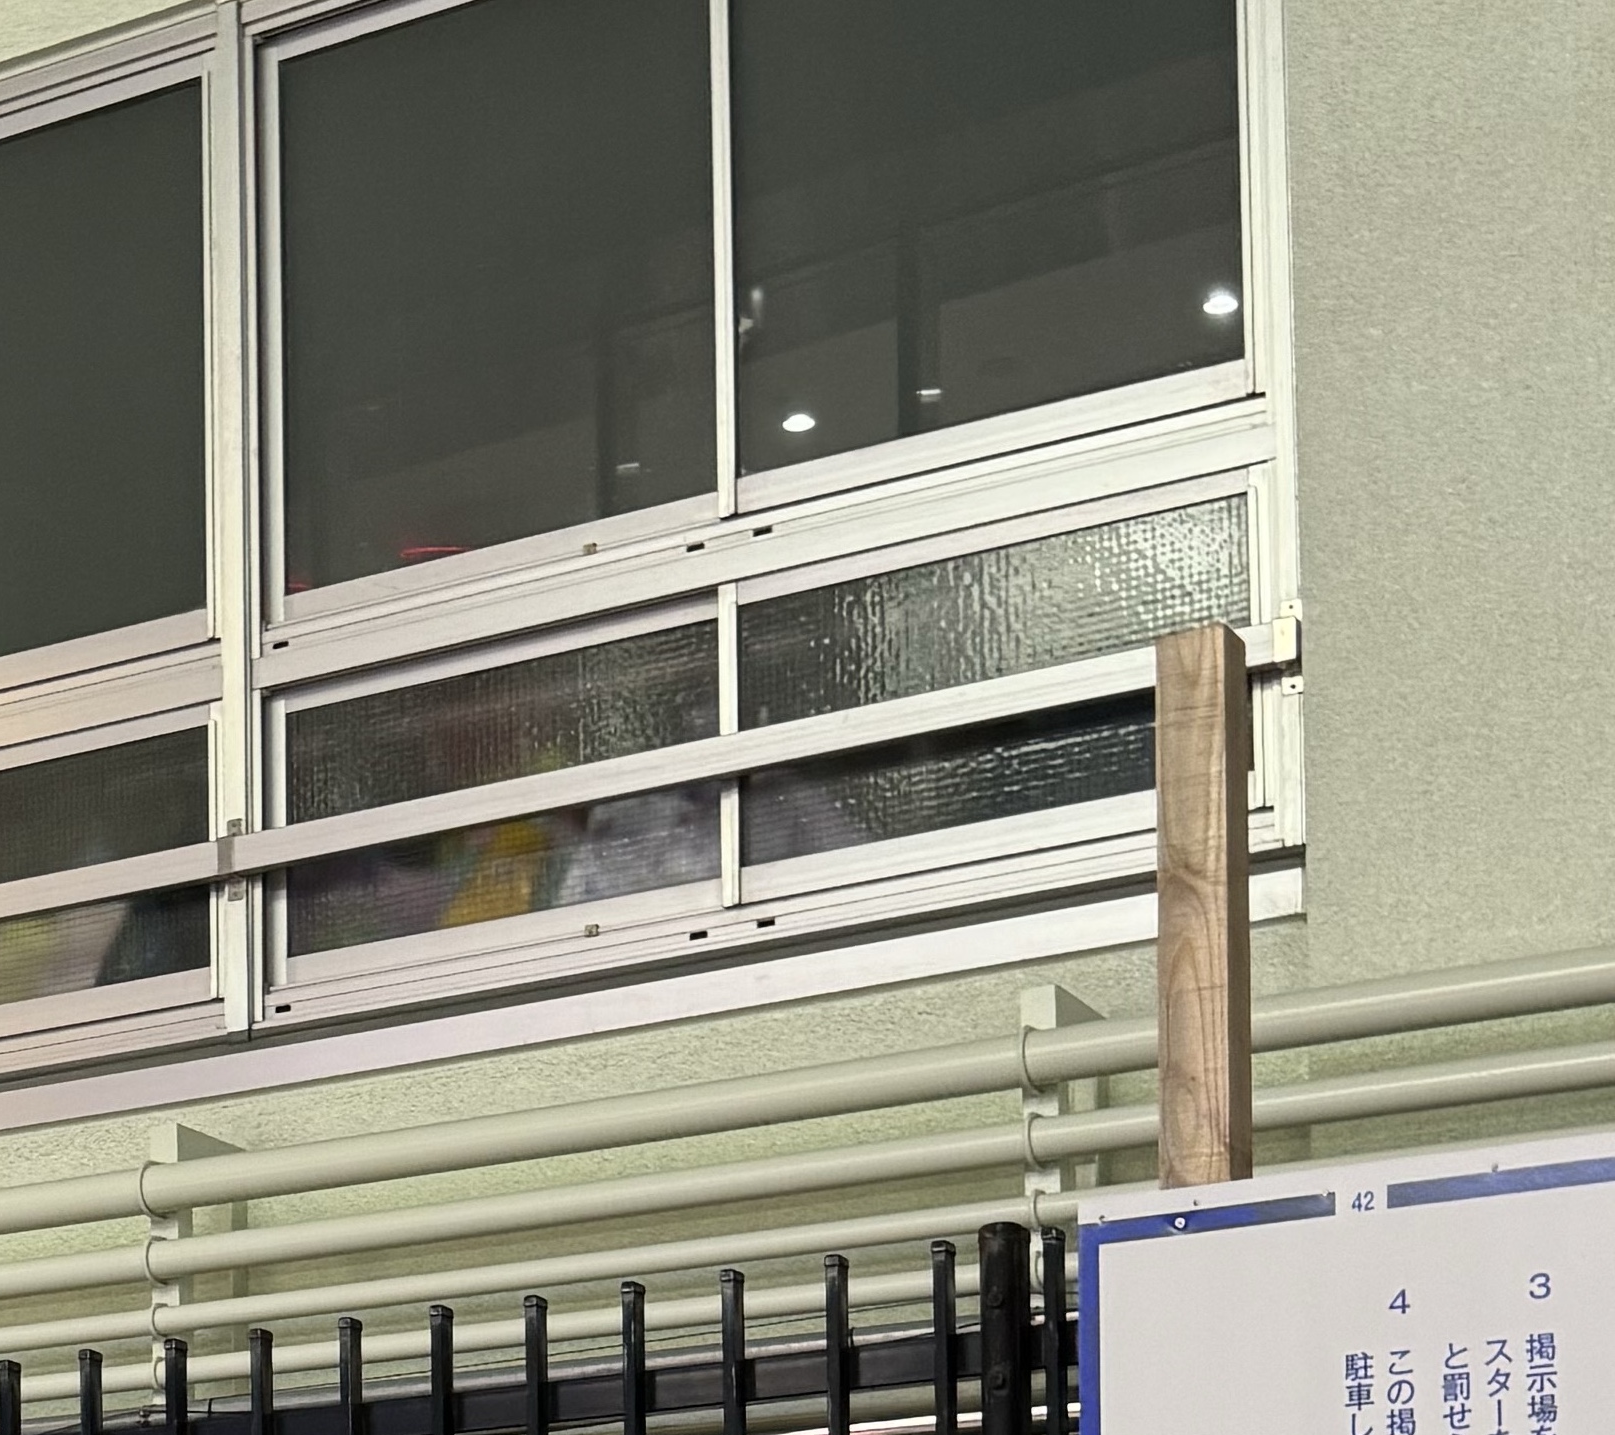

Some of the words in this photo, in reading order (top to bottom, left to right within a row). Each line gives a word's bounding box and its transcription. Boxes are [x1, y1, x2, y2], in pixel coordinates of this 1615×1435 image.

[1351, 1190, 1375, 1213] 42
[1528, 1272, 1552, 1300] 3
[1388, 1288, 1411, 1315] 4
